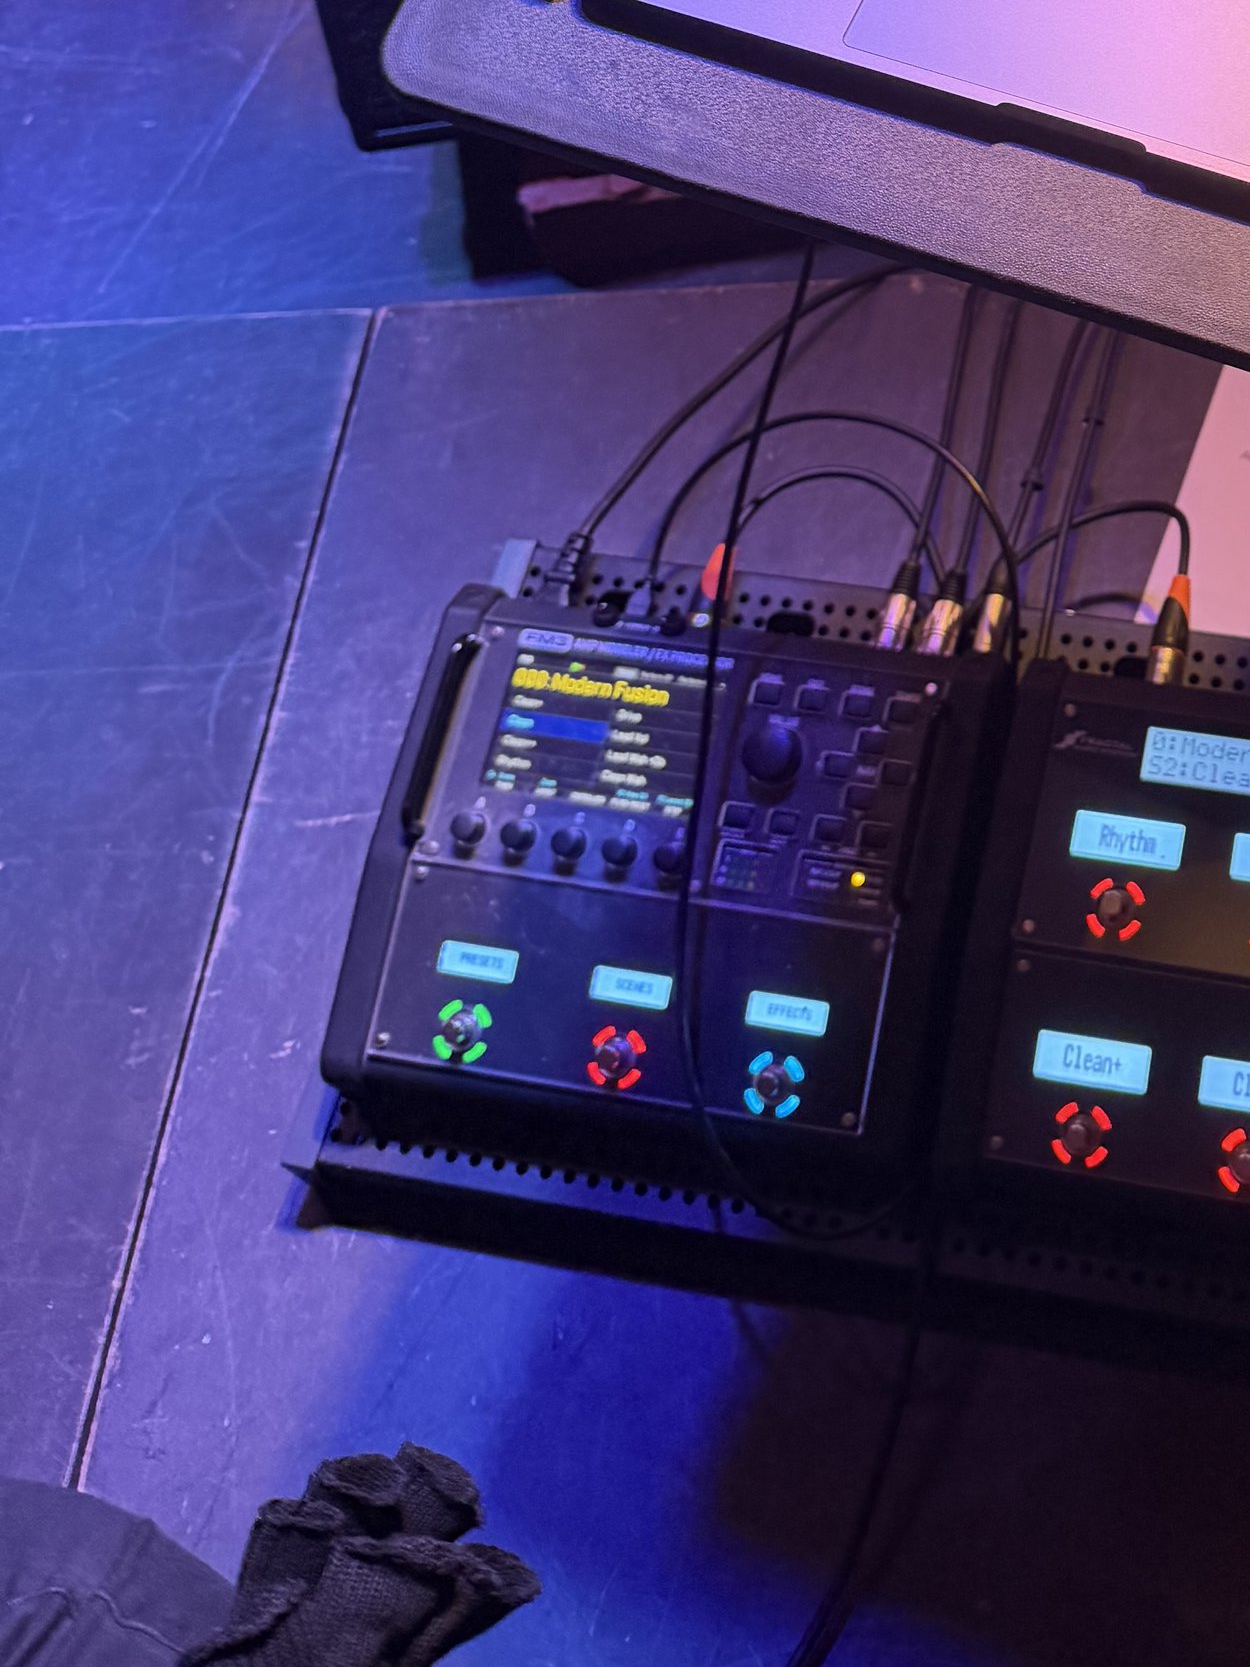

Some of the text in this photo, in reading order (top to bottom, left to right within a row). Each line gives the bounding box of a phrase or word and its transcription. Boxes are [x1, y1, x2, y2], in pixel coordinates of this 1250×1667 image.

[612, 681, 670, 707] Fusion
[1099, 824, 1156, 857] Rhythm
[460, 950, 505, 971] PRESETS
[615, 976, 654, 997] SCENES
[766, 1002, 814, 1023] EFFECTS
[1062, 1043, 1122, 1076] Clean+
